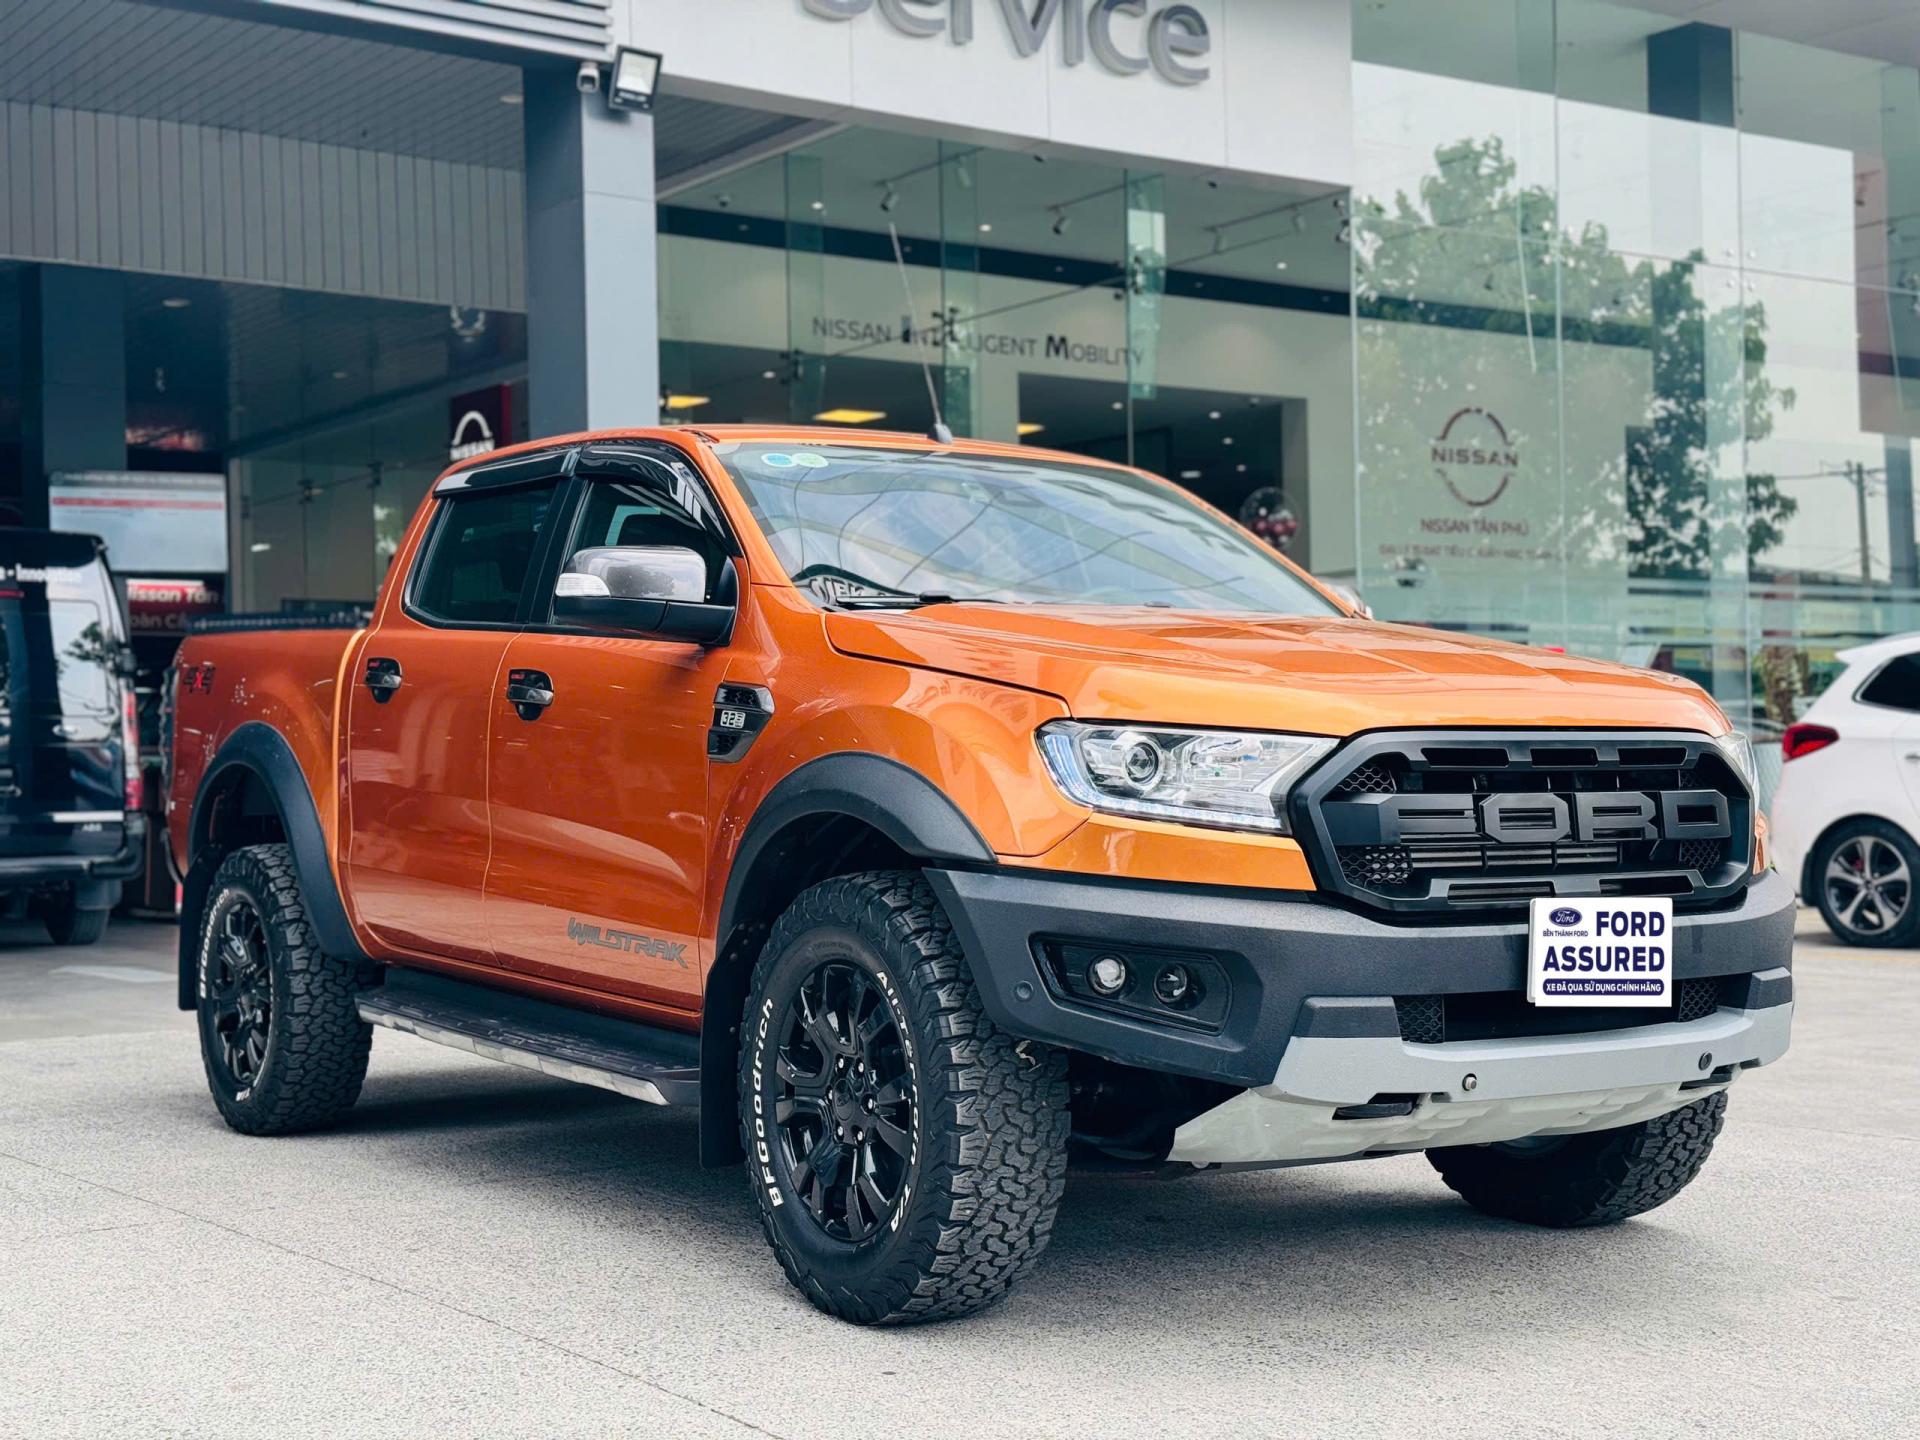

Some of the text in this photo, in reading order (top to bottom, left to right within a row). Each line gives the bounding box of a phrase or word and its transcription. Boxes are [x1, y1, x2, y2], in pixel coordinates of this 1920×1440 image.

[799, 0, 1211, 86] ervice
[811, 316, 892, 343] NISSAN
[1431, 447, 1519, 468] NISSAN
[1420, 517, 1470, 534] NISSAN
[1374, 790, 1732, 843] FORD
[753, 998, 785, 1207] BFGoodrich
